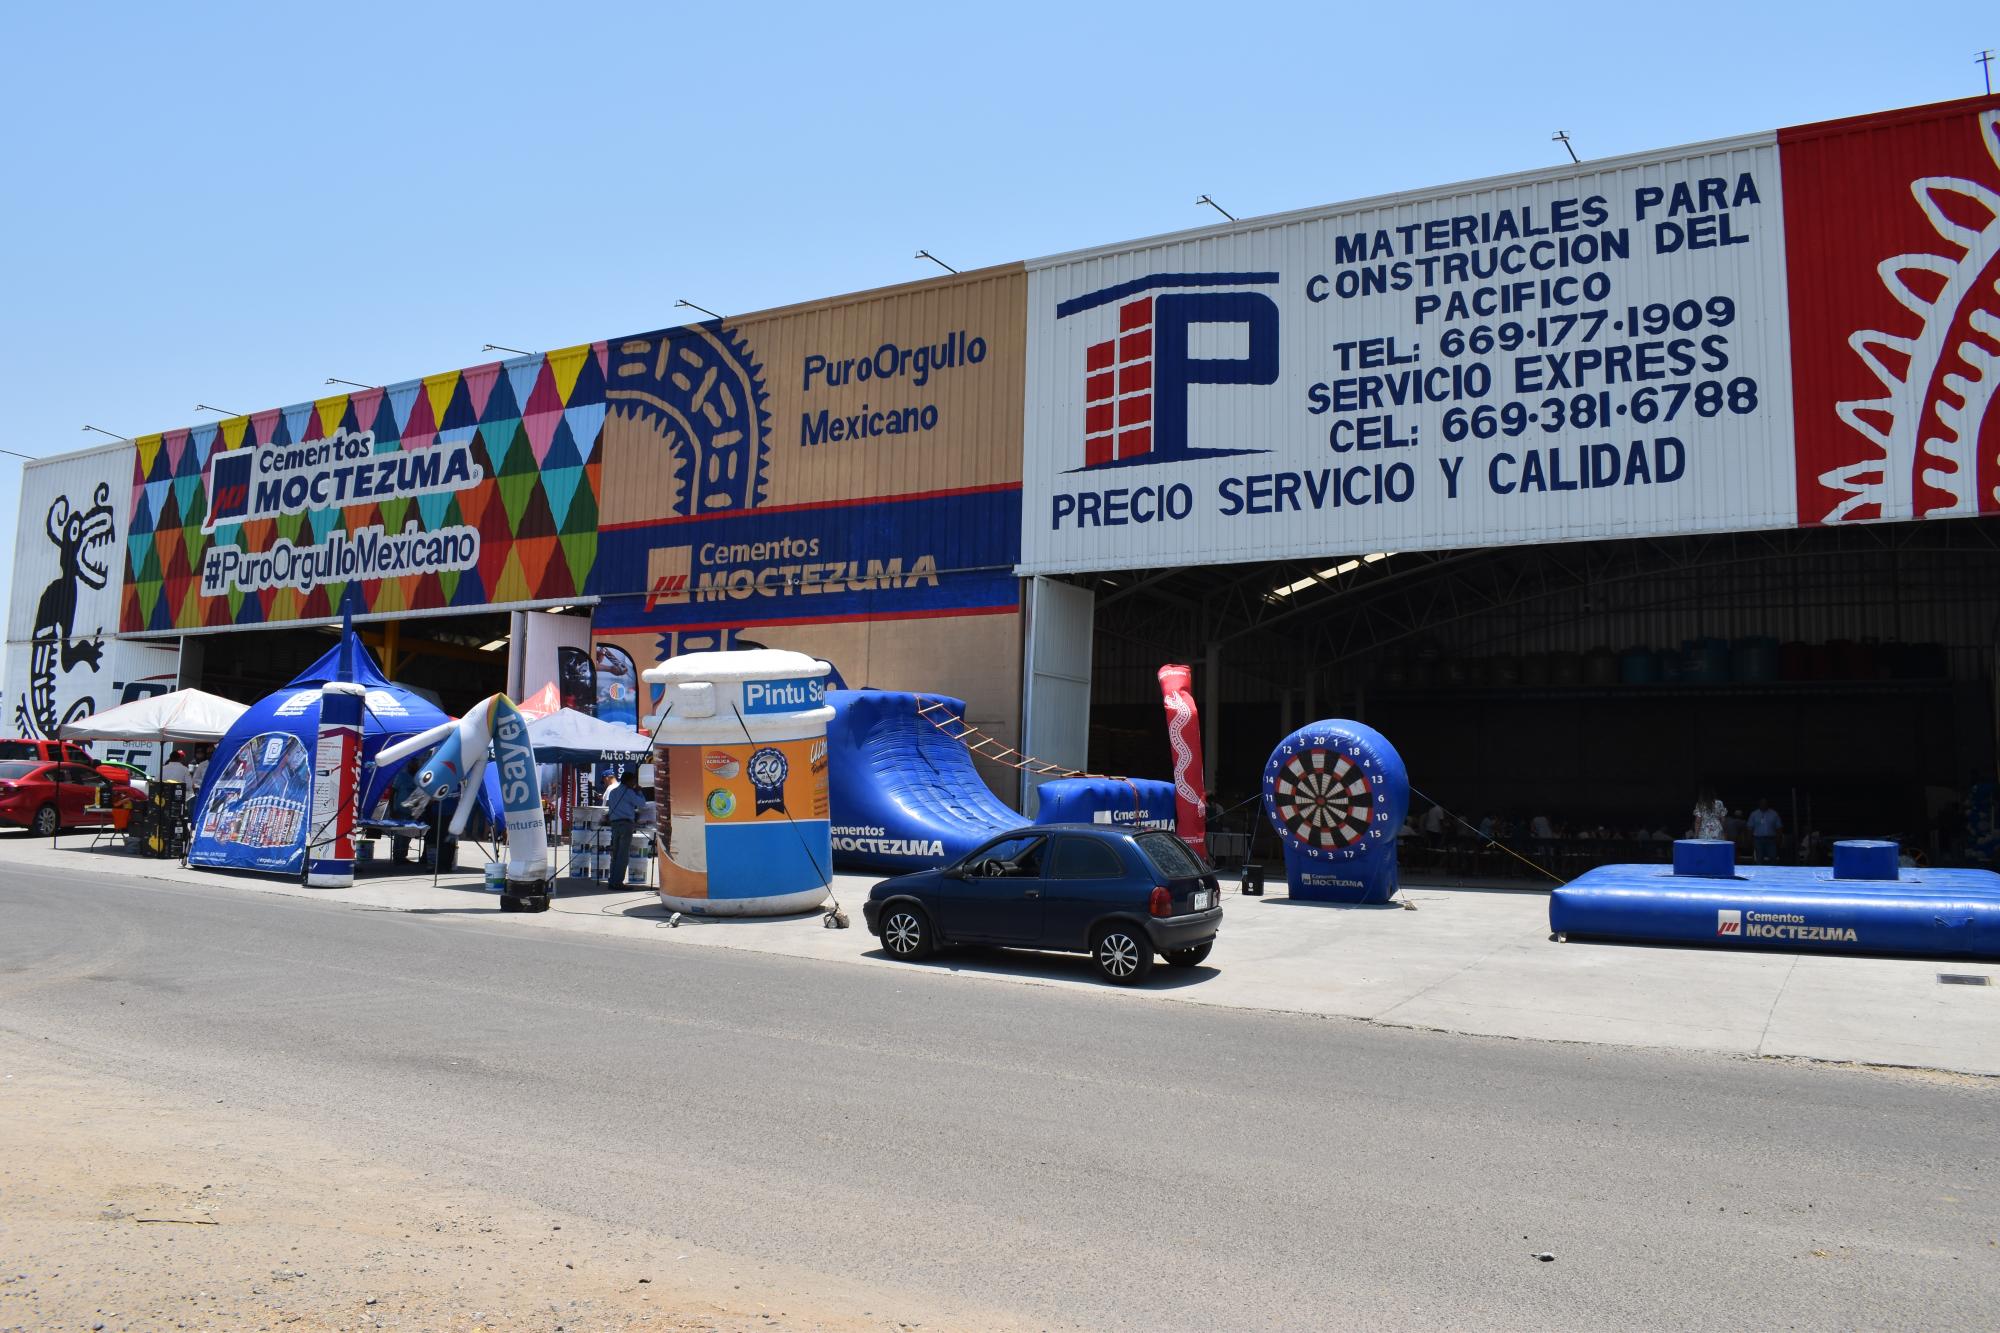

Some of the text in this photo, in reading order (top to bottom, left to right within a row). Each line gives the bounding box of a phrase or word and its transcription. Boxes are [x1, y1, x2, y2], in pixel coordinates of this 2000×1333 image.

[1335, 172, 1761, 264] MATERIALES PARA
[1306, 213, 1750, 303] CONSTRUCCION DEL
[1415, 272, 1611, 324] PACIFICO
[1333, 337, 1420, 371] TEL:
[803, 330, 986, 390] PuroOrgullo
[1307, 334, 1729, 414] SERVICIO EXPRESS
[800, 404, 938, 447] Mexicano
[1329, 415, 1418, 453] CEL:
[259, 435, 371, 473] Cementos
[254, 448, 471, 513] MOCTEZUMA
[1052, 437, 1686, 530] PRECIO SERVICIO Y CALIDAD
[700, 536, 819, 566] Cementos
[204, 532, 475, 589] #PuroOrgulloMexicano
[697, 555, 939, 603] MOCTEZUMA
[747, 683, 804, 706] Pintu
[1314, 736, 1325, 745] 20
[1333, 739, 1338, 747] 1
[600, 749, 624, 760] Auto
[1283, 746, 1292, 754] 12
[1349, 747, 1360, 756] 18
[757, 760, 779, 774] 20
[1273, 760, 1278, 768] 9
[1364, 760, 1370, 768] 4
[1266, 776, 1274, 784] 14
[1372, 776, 1383, 784] 13
[1266, 794, 1273, 802] 11
[1378, 795, 1385, 803] 6
[1271, 812, 1276, 820] 8
[1376, 813, 1388, 821] 10
[507, 819, 544, 831] inturas
[831, 825, 885, 836] ementos
[1279, 828, 1288, 836] 16
[1370, 830, 1381, 838] 15
[1360, 843, 1366, 851] 2
[1308, 850, 1318, 858] 19
[1328, 852, 1334, 860] 3
[1344, 851, 1354, 859] 17
[1746, 911, 1805, 924] Cementos
[1746, 924, 1858, 942] MOCTEZUMA
